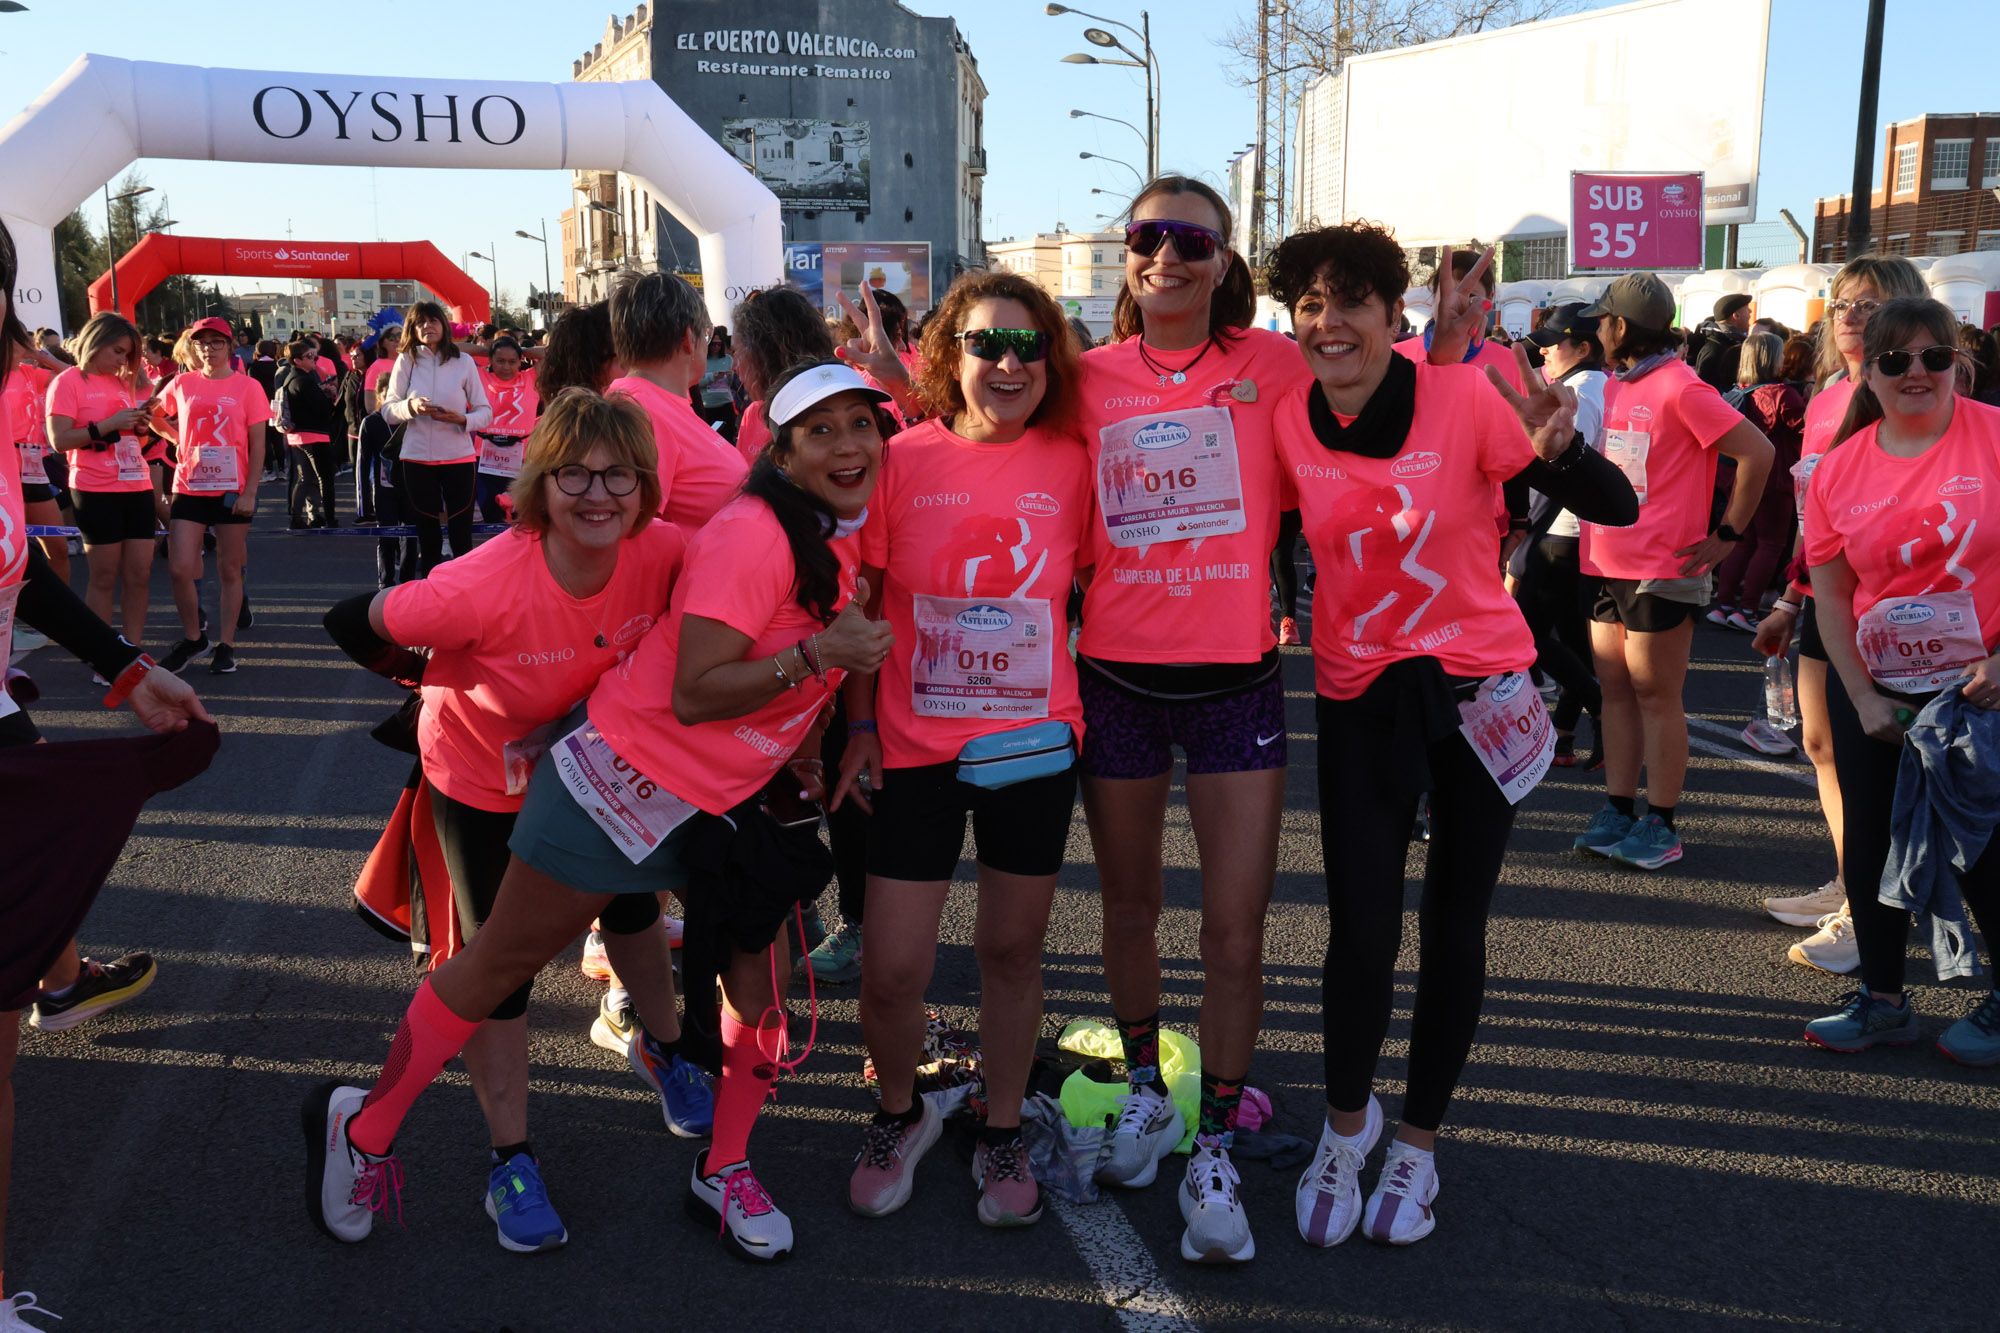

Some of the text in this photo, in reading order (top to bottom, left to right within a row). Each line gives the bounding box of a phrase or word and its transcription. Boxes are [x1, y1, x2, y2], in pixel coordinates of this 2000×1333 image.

[677, 30, 915, 58] EL PUERTO VALENCIA.com
[697, 60, 891, 79] Restaurante Tematico
[253, 86, 526, 145] OYSHO
[1589, 185, 1643, 211] SUB
[1660, 209, 1697, 218] OYSHO
[236, 248, 349, 261] Sports Santander
[1105, 395, 1160, 409] OYSHO
[1137, 432, 1187, 446] ASTURIANA
[202, 466, 221, 474] 016
[1395, 459, 1438, 474] ASTURIANA
[1144, 468, 1197, 492] 016
[914, 493, 970, 509] OYSHO
[1019, 499, 1056, 512] ASTURIANA
[1163, 496, 1176, 505] 45
[1851, 495, 1899, 515] OYSHO
[1120, 514, 1146, 523] CARRERA
[1167, 508, 1189, 517] MUJER
[1195, 503, 1225, 512] VALENCIA
[1121, 519, 1229, 540] OYSHO Santander
[1113, 564, 1249, 584] CARRERA DE LA MUJER
[1168, 585, 1191, 596] 2025
[960, 614, 1008, 626] ASTURIANA
[1889, 611, 1932, 622] ASTURIANA
[1419, 622, 1463, 652] MUJER
[518, 647, 575, 665] OYSHO
[1898, 639, 1944, 657] 016
[958, 650, 1009, 672] 016
[967, 676, 992, 685] 5260
[926, 686, 954, 694] CARRERA
[956, 687, 964, 695] DE
[923, 699, 1033, 712] OYSHO Santander
[1517, 694, 1541, 735] 016
[561, 757, 588, 796] OYSHO
[612, 755, 657, 800] 016
[1517, 757, 1546, 789] OYSHO
[576, 751, 645, 836] CARRERA DE LA MUJER VALENCIA
[610, 781, 623, 794] 46
[603, 814, 635, 848] Santander
